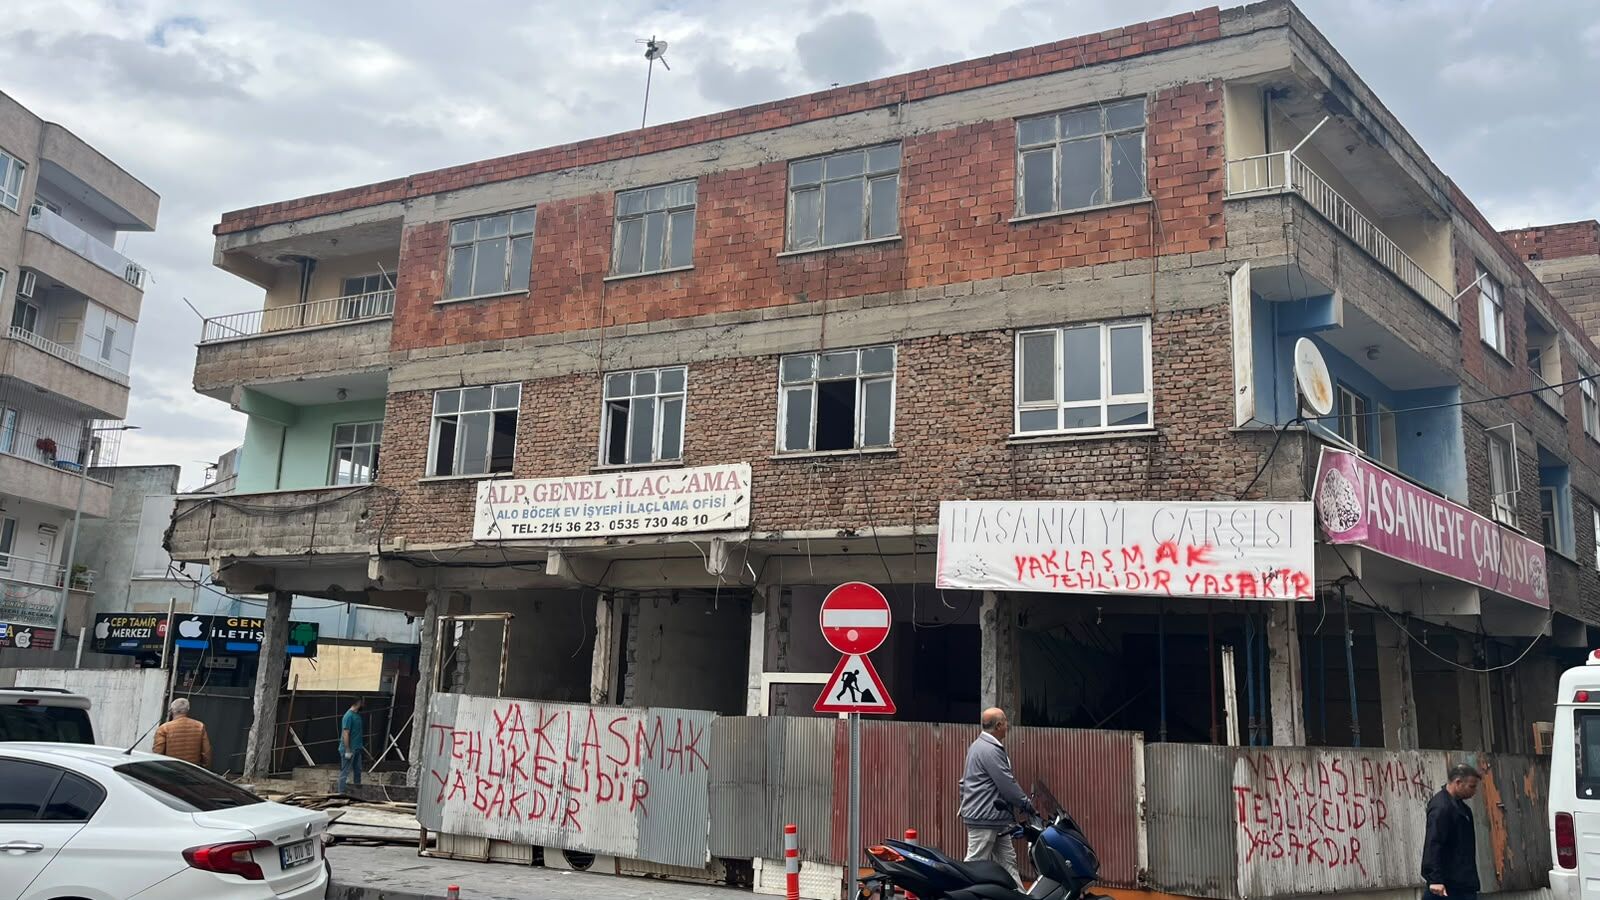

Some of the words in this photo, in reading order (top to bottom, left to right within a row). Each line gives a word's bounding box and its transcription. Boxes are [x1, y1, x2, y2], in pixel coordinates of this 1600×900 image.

[484, 484, 526, 504] ALP
[532, 480, 607, 502] GENEL
[496, 509, 519, 520] ALO
[522, 506, 560, 519] BÖCEK
[564, 506, 579, 517] EV
[583, 501, 622, 518] İŞYERİ
[626, 498, 689, 514] İLAÇLAMA
[692, 494, 726, 510] OFİSİ
[511, 524, 537, 534] TEL:
[541, 522, 562, 533] 215
[566, 521, 581, 532] 36
[585, 520, 600, 531] 23
[609, 519, 639, 531] 0535
[644, 517, 668, 529] 730
[672, 516, 688, 527] 48
[693, 514, 708, 525] 10
[111, 617, 128, 627] CEP
[129, 616, 157, 628] TAMİR
[227, 618, 266, 628] GEN
